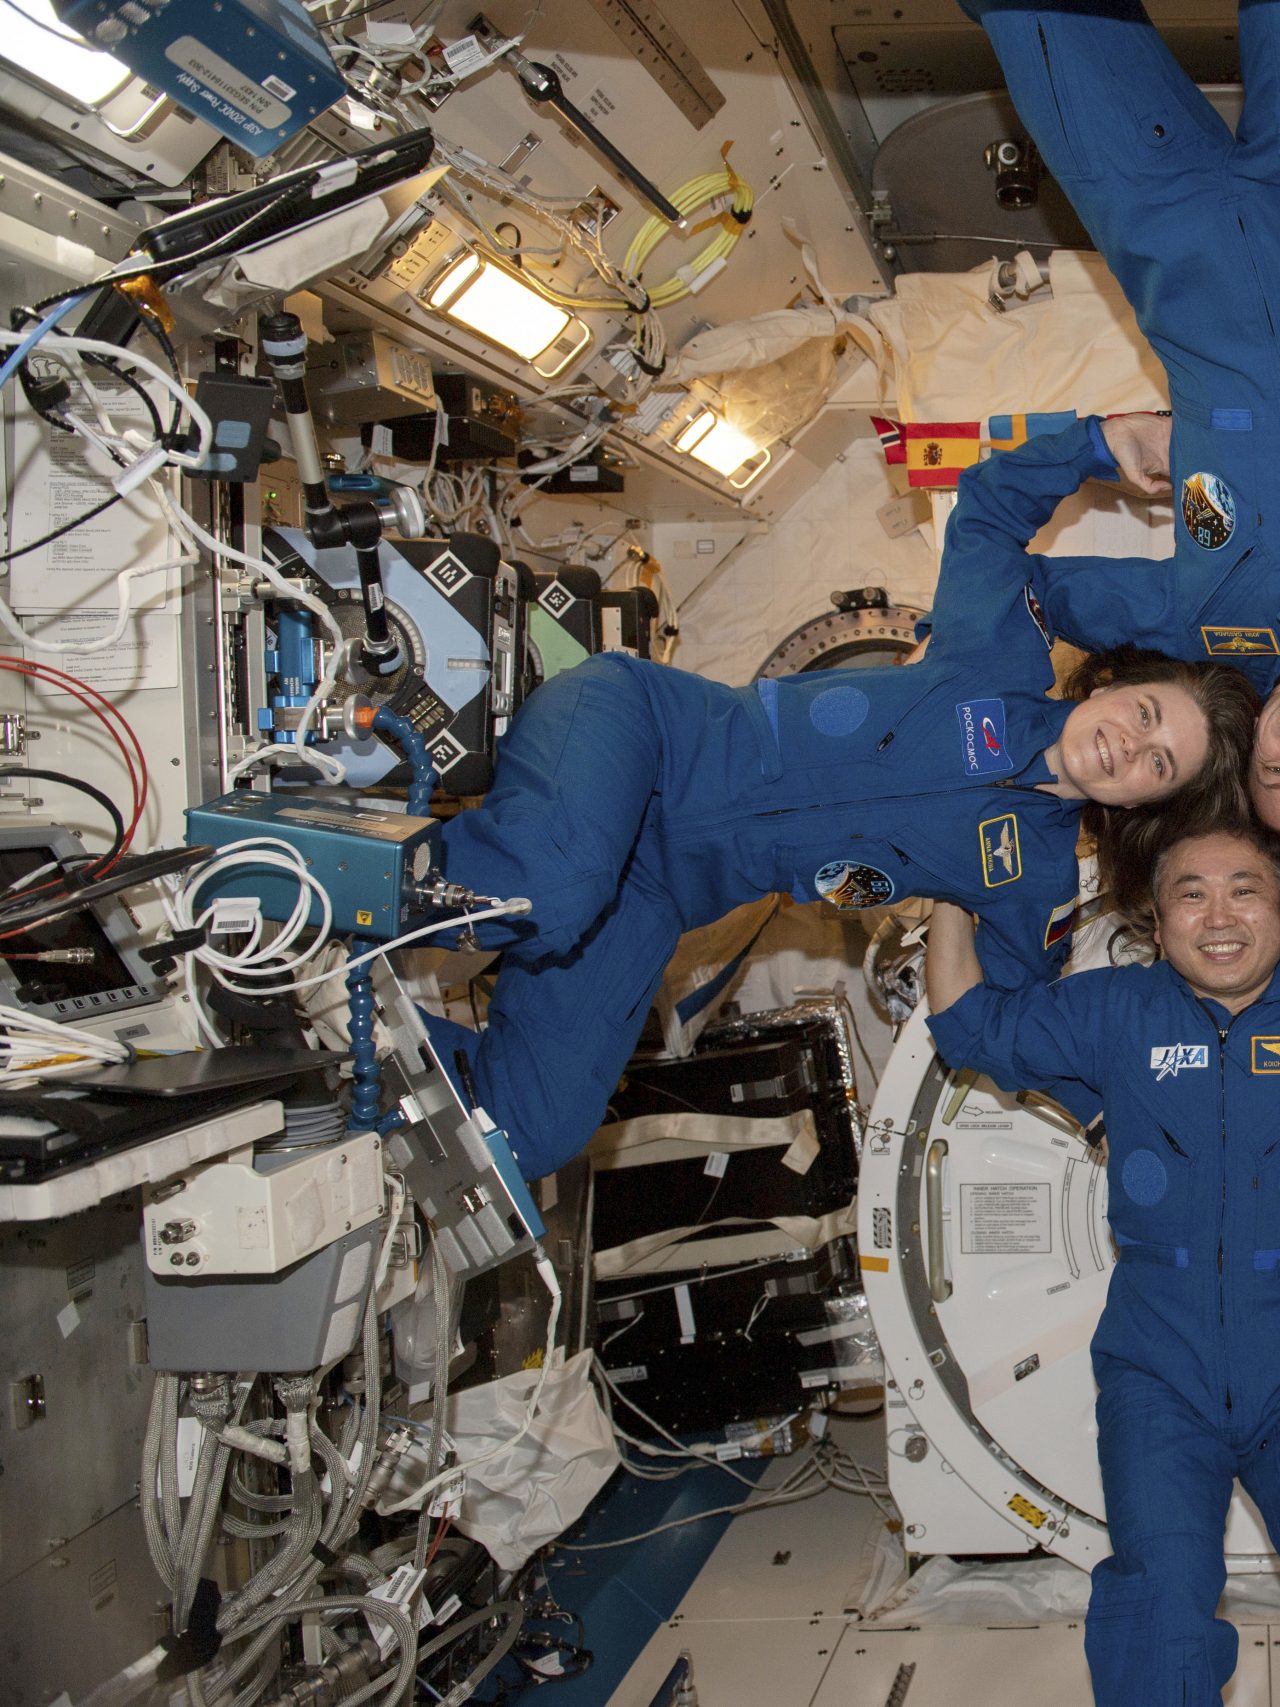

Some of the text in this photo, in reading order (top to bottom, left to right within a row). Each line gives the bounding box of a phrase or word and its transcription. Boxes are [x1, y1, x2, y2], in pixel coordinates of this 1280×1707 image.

[176, 72, 200, 93] Supply
[199, 90, 221, 107] Power
[1197, 526, 1211, 547] 68
[962, 706, 979, 771] РОСКОСМОС
[1152, 1043, 1207, 1081] JAXA
